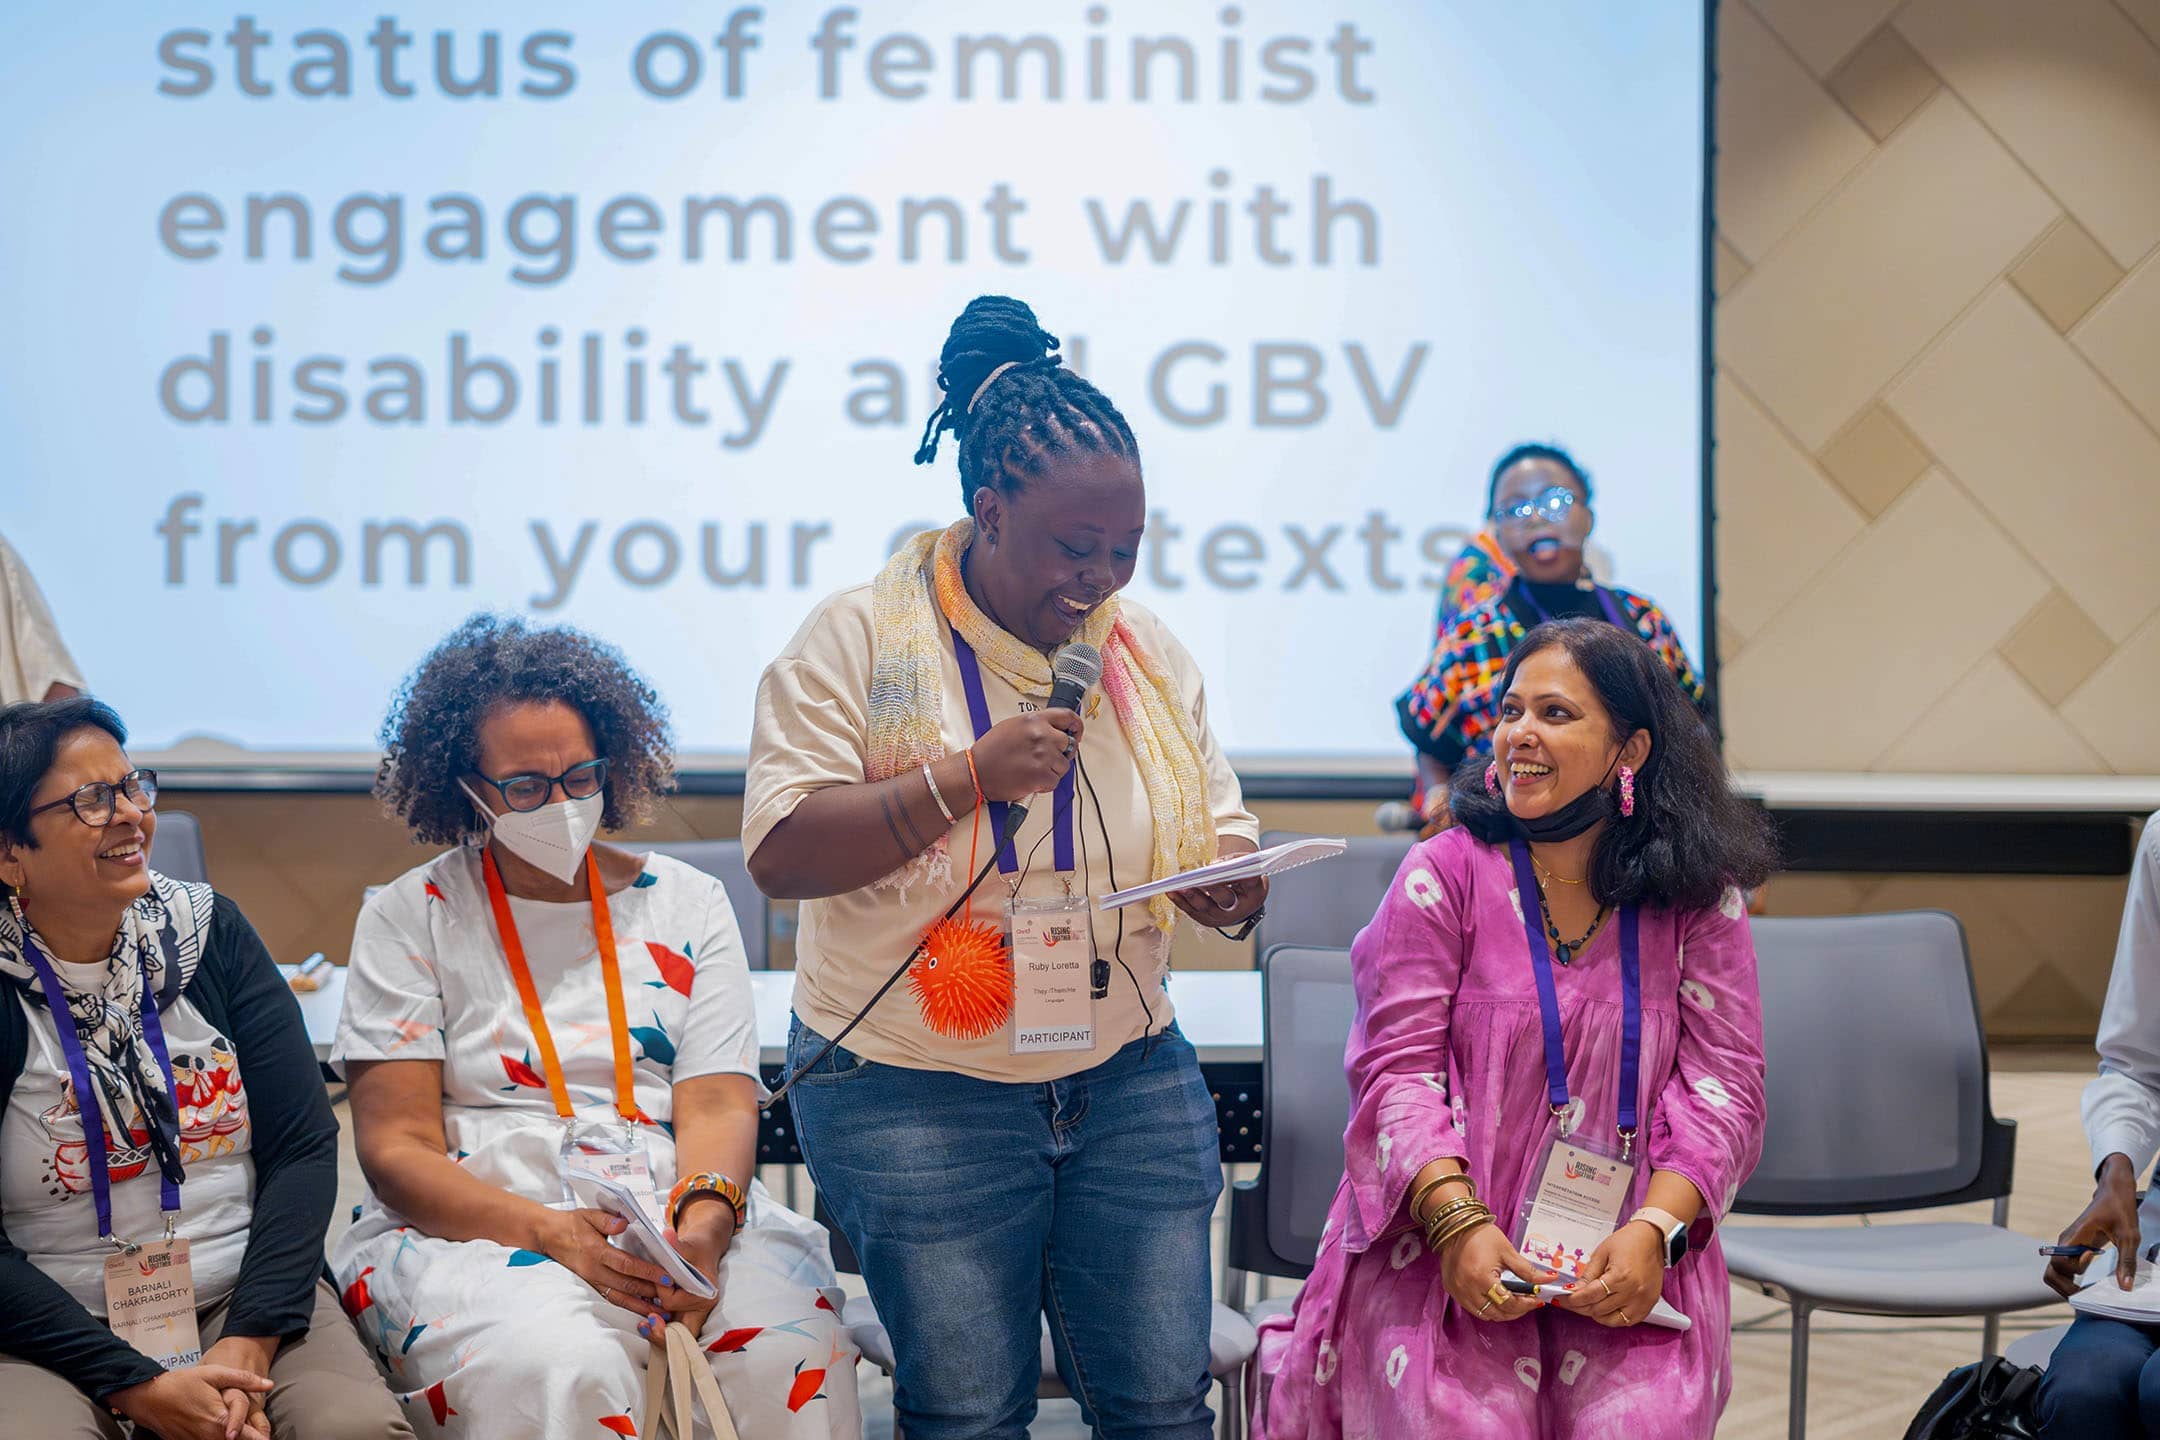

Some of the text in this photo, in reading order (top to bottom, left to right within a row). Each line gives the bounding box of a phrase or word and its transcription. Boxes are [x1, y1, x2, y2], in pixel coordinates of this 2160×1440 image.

[157, 4, 1376, 103] status of feminist
[158, 169, 1379, 287] engagement with
[158, 325, 793, 451] disability
[1148, 341, 1431, 429] GBV
[155, 493, 472, 589] from
[527, 518, 832, 610] your
[1029, 962, 1080, 972] Ruby Loretta
[1021, 1030, 1090, 1044] PARTICIPANT
[128, 1280, 171, 1296] BARNALI
[112, 1288, 189, 1311] CHAKRABORTY
[112, 1319, 141, 1329] BARNALI
[159, 1351, 200, 1369] CIPANT
